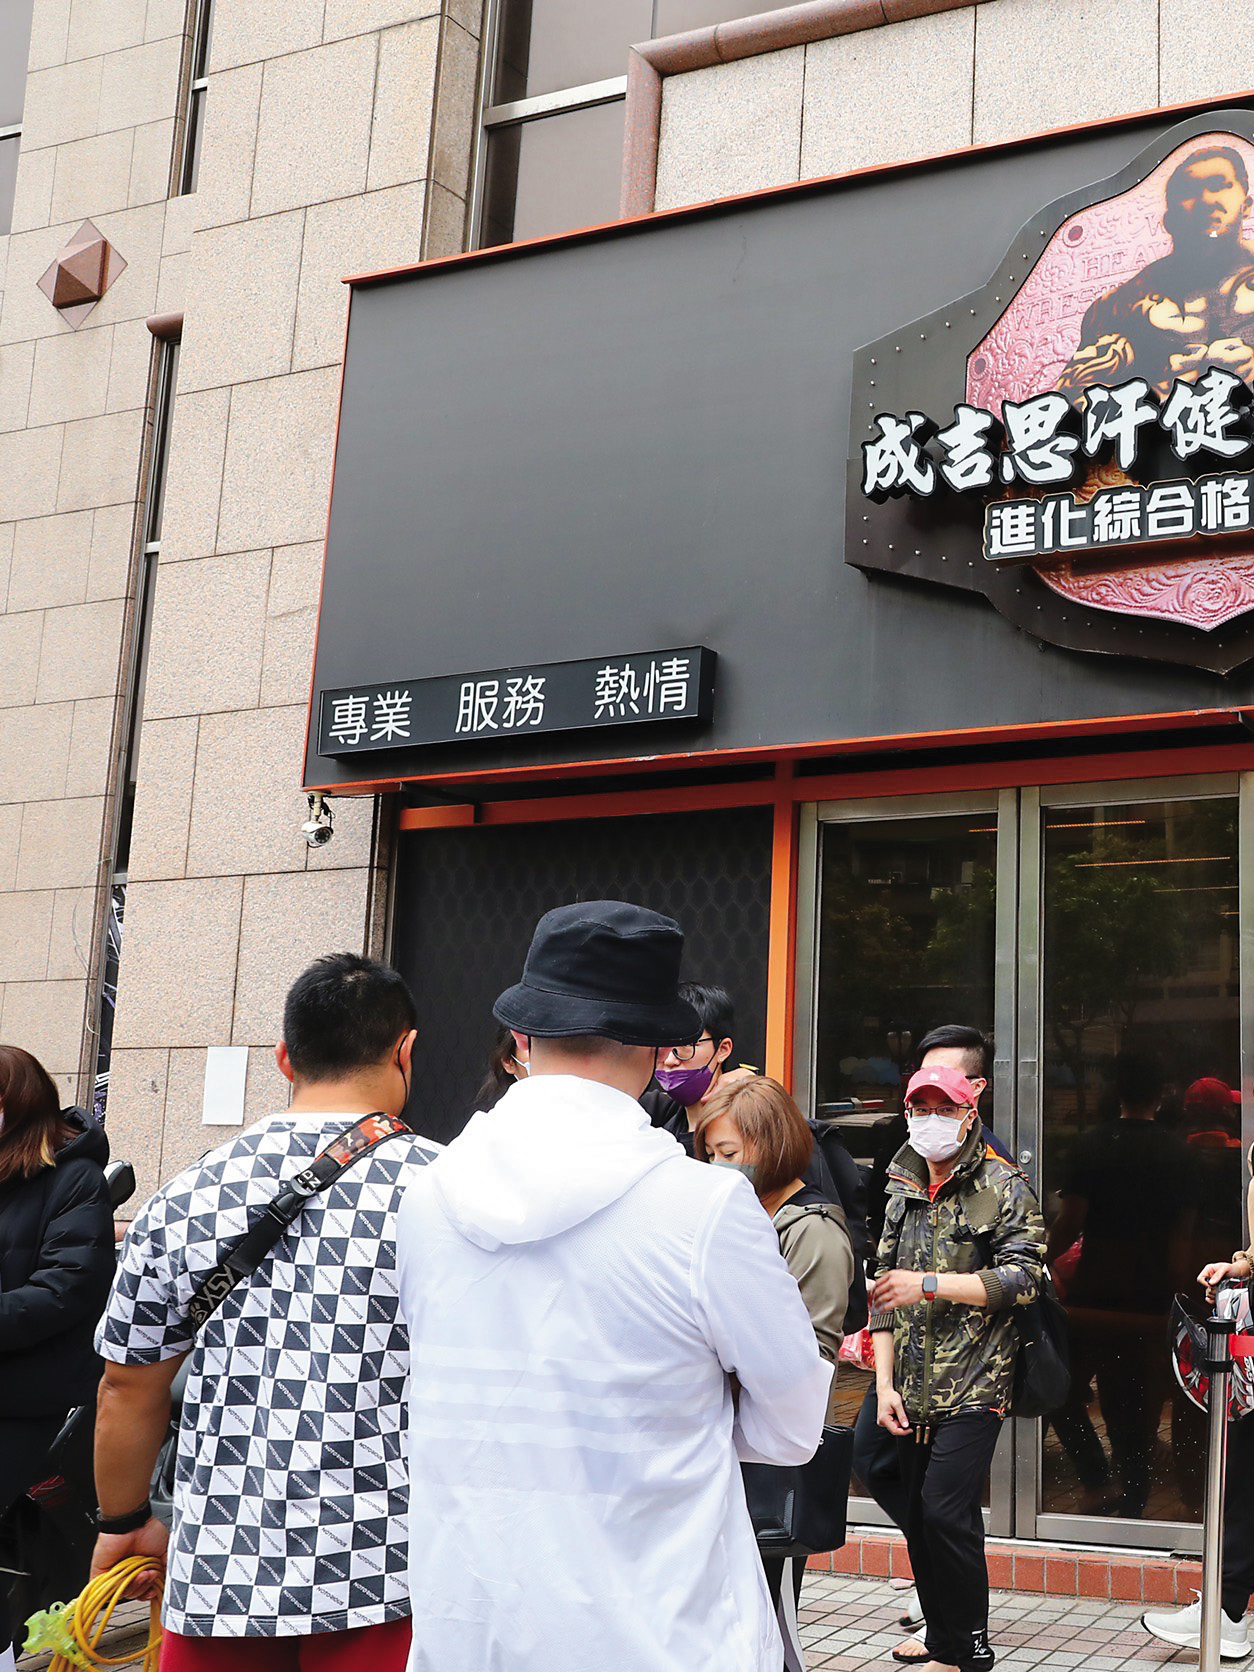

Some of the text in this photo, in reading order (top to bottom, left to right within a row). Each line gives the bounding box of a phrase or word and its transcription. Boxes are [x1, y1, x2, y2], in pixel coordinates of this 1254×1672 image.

[328, 657, 691, 746] 專業 服務 熱情
[378, 1271, 399, 1294] NOTORIOUS
[241, 1320, 264, 1343] NOTORIOUS
[337, 1326, 360, 1350] NOTORIOUS
[236, 1349, 259, 1370] NOTORIOUS
[231, 1379, 255, 1402] NOTORIOUS
[227, 1408, 250, 1430] NOTORIOUS
[327, 1415, 350, 1436] NOTORIOUS
[221, 1439, 245, 1462] NOTORIOUS
[324, 1445, 350, 1465] NOTORIOUS
[216, 1468, 239, 1490] NOTORIOUS
[291, 1474, 316, 1495] NOTORIOUS
[324, 1471, 349, 1491] NOTORIOUS
[357, 1470, 384, 1488] NOTORIOUS
[210, 1498, 234, 1521] NOTORIOUS
[323, 1498, 350, 1519] NOTORIOUS
[204, 1527, 227, 1549] NOTORIOUS
[290, 1532, 313, 1554] NOTORIOUS
[322, 1528, 347, 1547] NOTORIOUS
[357, 1524, 383, 1544] NOTORIOUS
[197, 1558, 220, 1581] NOTORIOUS
[319, 1558, 346, 1578] NOTORIOUS
[356, 1553, 382, 1572] NOTORIOUS
[192, 1586, 213, 1609] NOTORIOUS
[225, 1588, 247, 1612] NOTORIOUS
[283, 1590, 308, 1612] NOTORIOUS
[317, 1586, 344, 1605] NOTORIOUS
[353, 1582, 380, 1602] NOTORIOUS
